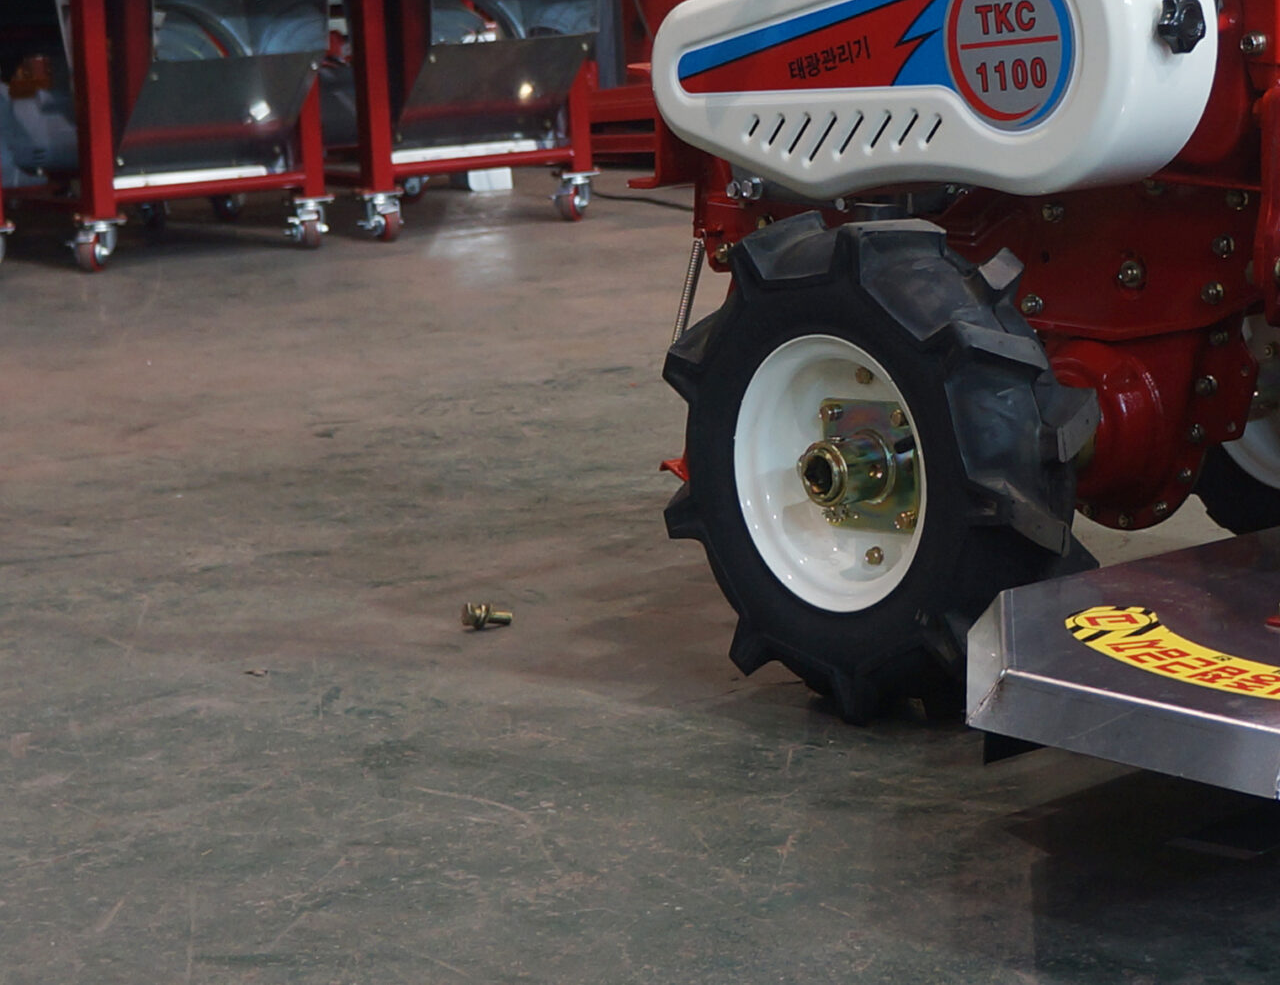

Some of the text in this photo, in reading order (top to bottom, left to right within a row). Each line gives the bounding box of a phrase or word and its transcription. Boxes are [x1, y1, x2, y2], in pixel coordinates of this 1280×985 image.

[974, 0, 1036, 36] TKC
[788, 35, 871, 79] 태광관리기
[975, 56, 1048, 93] 1100
[1084, 613, 1140, 627] 고
